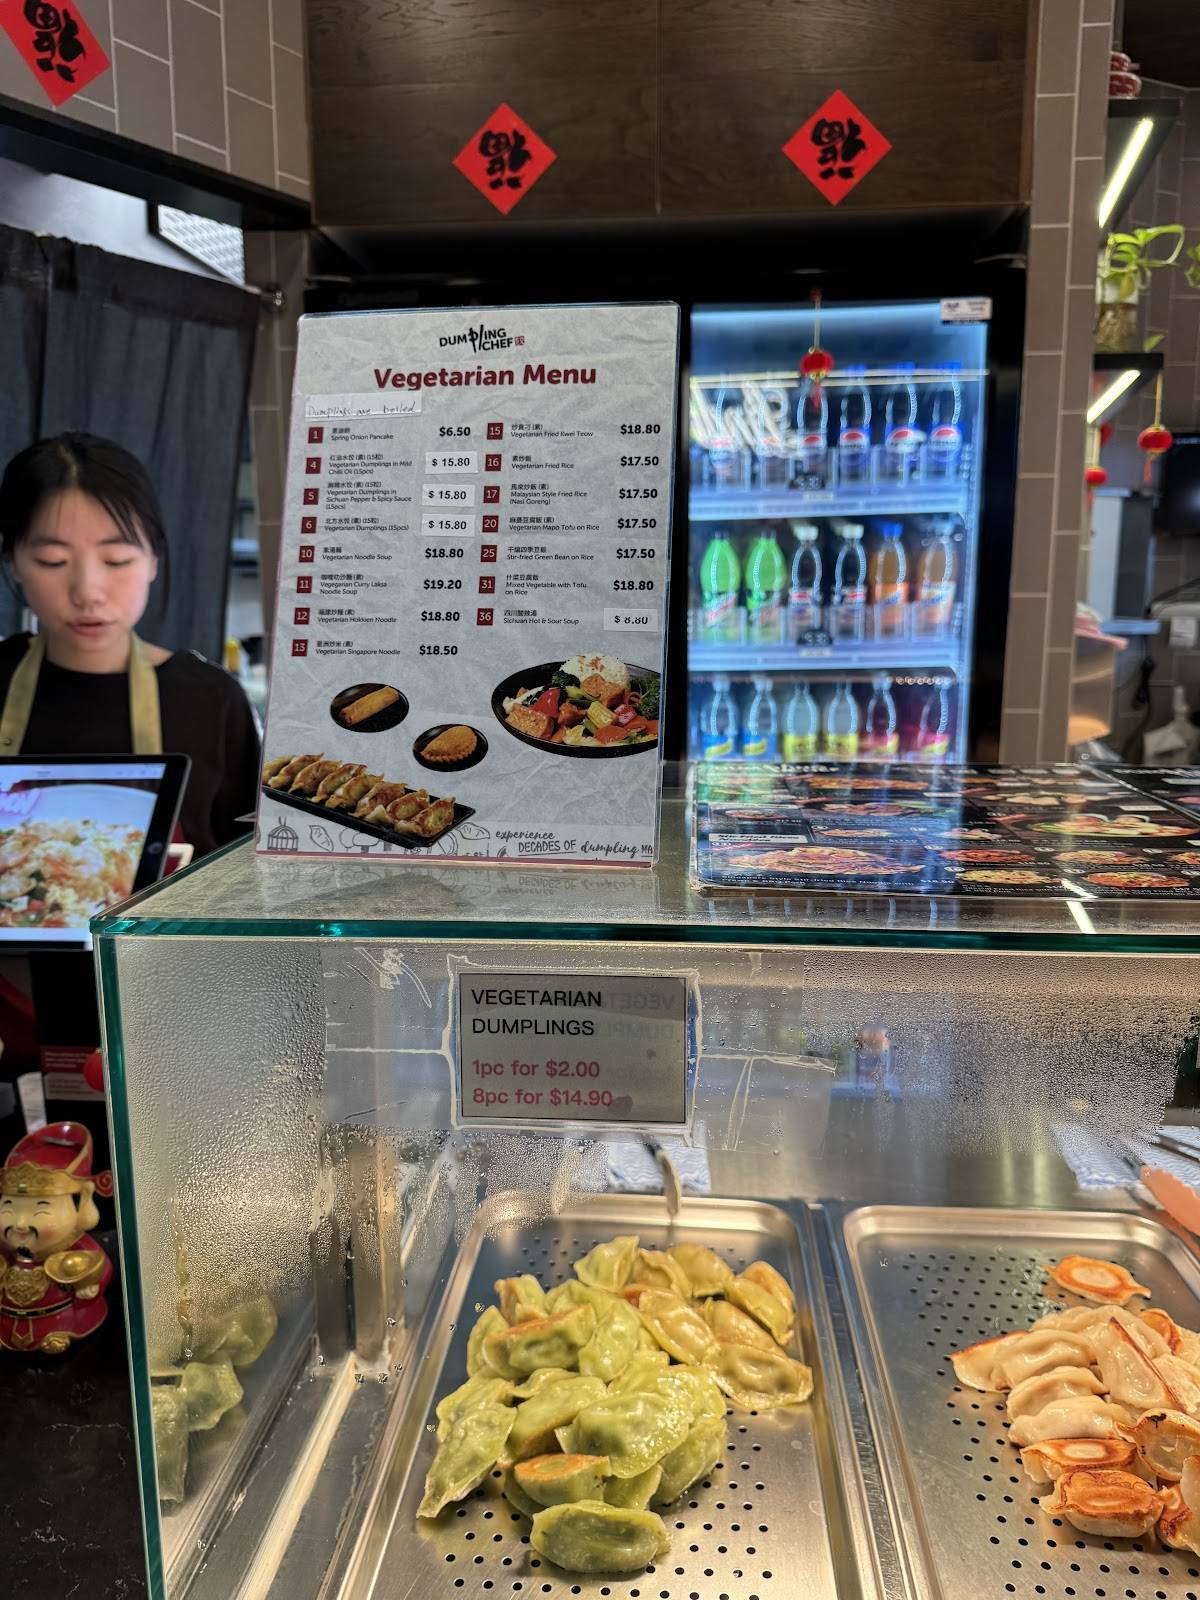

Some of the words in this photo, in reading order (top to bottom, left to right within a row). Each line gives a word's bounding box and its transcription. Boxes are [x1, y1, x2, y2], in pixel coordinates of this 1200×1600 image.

[482, 338, 513, 351] CHEF
[374, 366, 514, 391] Vegetarian
[523, 364, 597, 385] Menu
[439, 426, 471, 437] $6.50
[510, 431, 543, 439] Vegetarian
[620, 424, 661, 435] $18.80
[331, 434, 350, 442] Spring
[432, 459, 438, 467] $
[442, 457, 470, 467] 15.80
[511, 463, 544, 471] Vegetarian
[620, 456, 659, 467] $17.50
[326, 489, 358, 497] Vegetarian
[428, 490, 435, 499] $
[439, 490, 467, 500] 15.80
[510, 491, 541, 499] Malaysian
[619, 488, 658, 499] $17.50
[377, 495, 393, 503] Spicy
[428, 520, 435, 529] $
[439, 520, 467, 530] 15.80
[509, 524, 542, 532] Vegetarian
[542, 524, 560, 532] Mapo
[617, 518, 657, 529] $17.50
[425, 548, 464, 559] $18.80
[616, 548, 656, 559] $17.50
[353, 581, 370, 589] Curry
[423, 579, 463, 590] $19.20
[613, 580, 654, 591] $18.80
[421, 610, 461, 623] $18.80
[614, 615, 621, 624] $
[347, 648, 378, 656] Singapore
[419, 645, 459, 657] $18.50
[495, 830, 556, 844] experience
[518, 840, 562, 854] DECADES
[563, 839, 577, 851] OF
[580, 841, 640, 859] dumpling
[471, 989, 602, 1008] VEGETARIAN
[472, 1018, 595, 1036] DUMPLINGS
[472, 1059, 505, 1078] 1pc
[511, 1059, 539, 1077] for
[546, 1059, 600, 1079] $2.00
[472, 1088, 508, 1107] 8pc
[514, 1088, 543, 1105] for
[550, 1088, 614, 1107] $14.90
